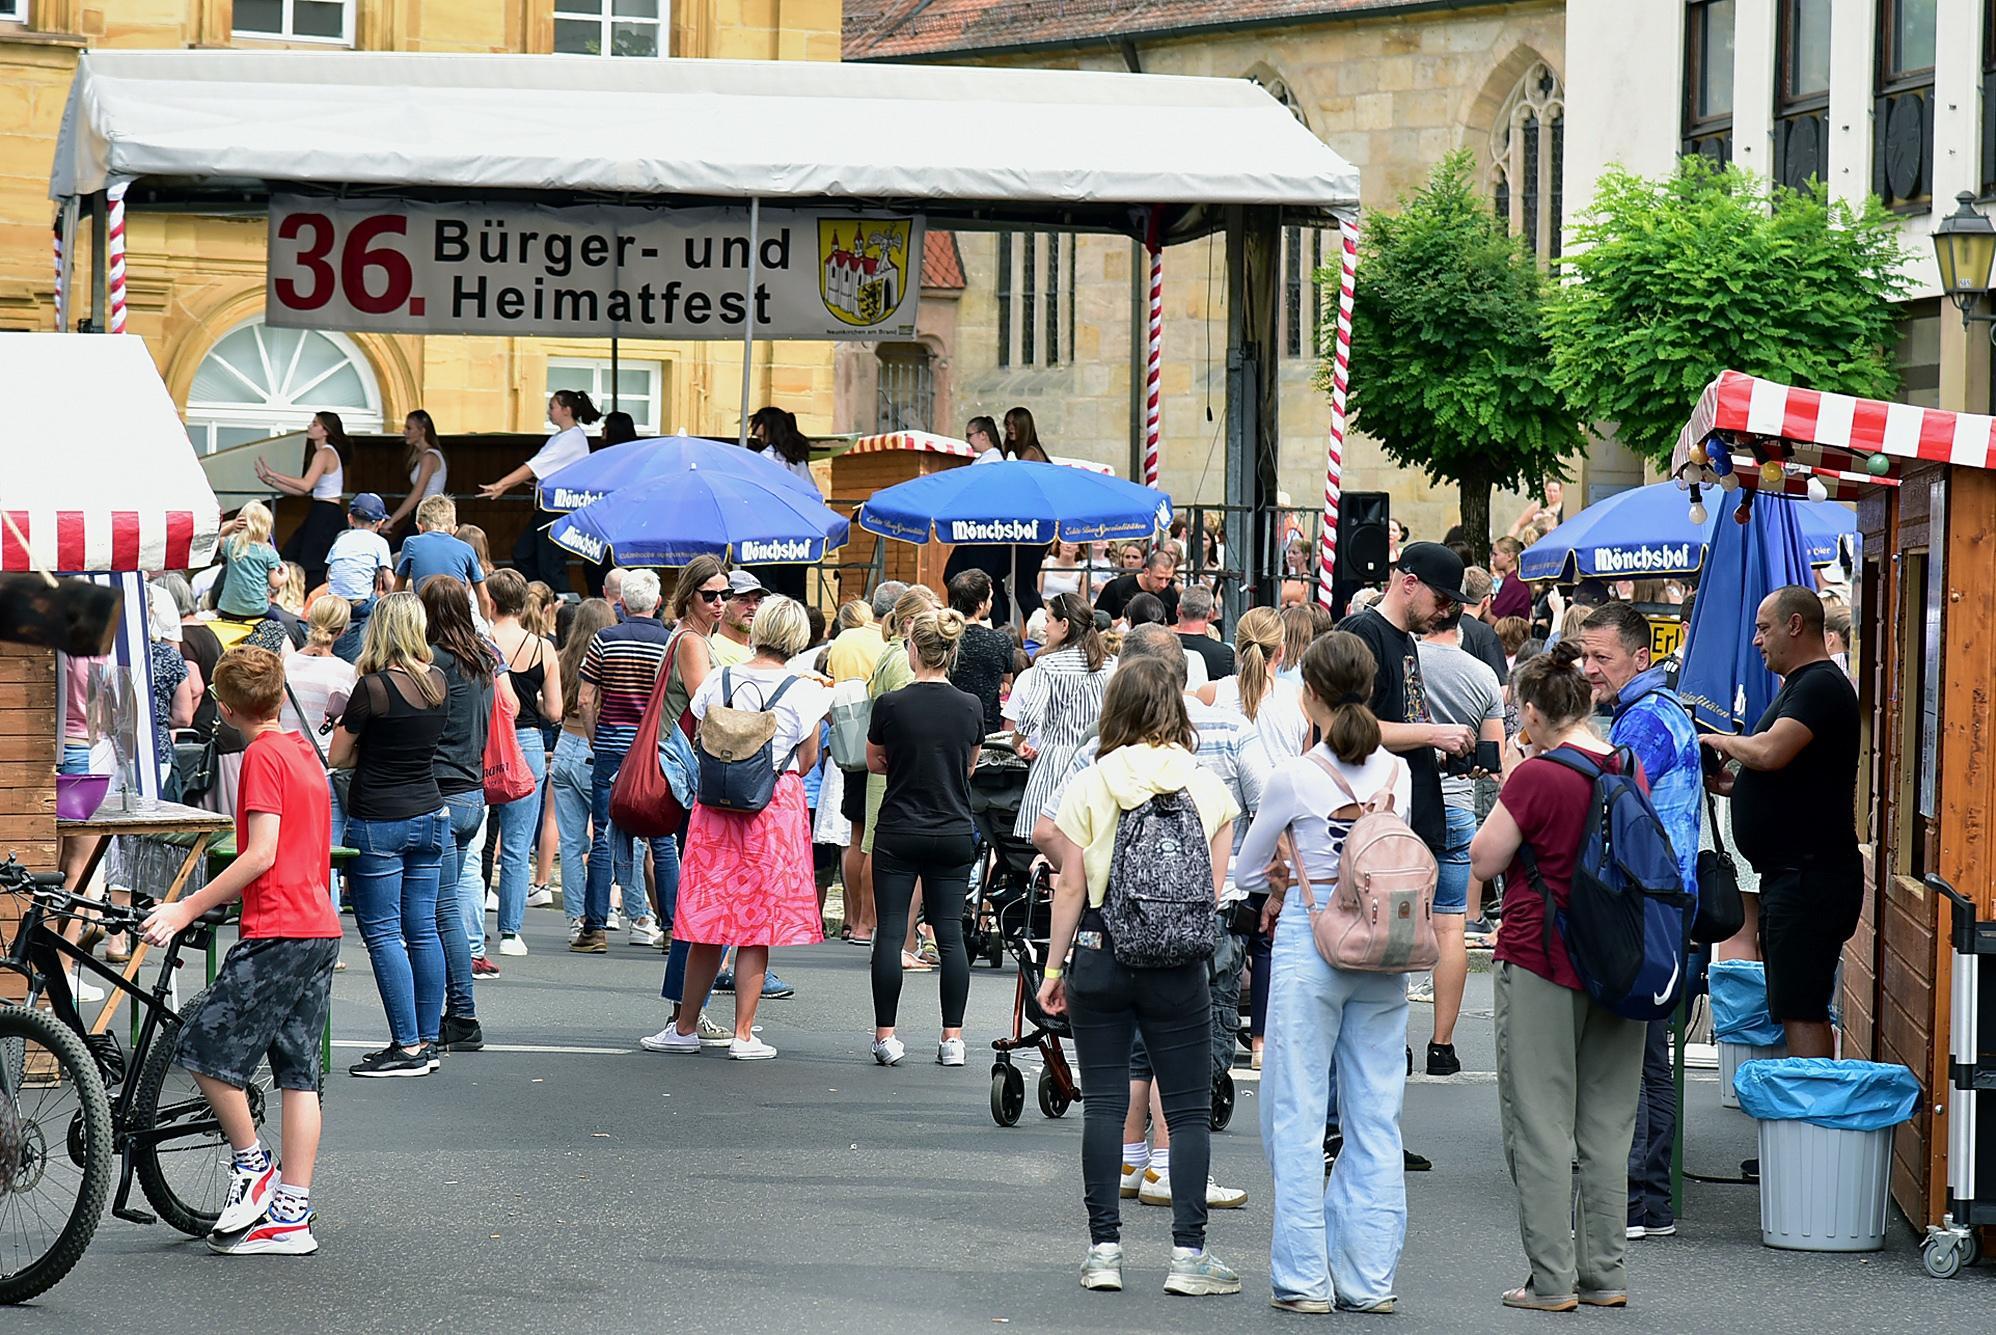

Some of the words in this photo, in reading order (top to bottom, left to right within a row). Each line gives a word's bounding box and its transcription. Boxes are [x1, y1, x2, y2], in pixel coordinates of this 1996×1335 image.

[434, 219, 658, 277] Bürger-
[685, 228, 790, 270] und
[274, 213, 425, 316] 36.
[452, 275, 772, 325] Heimatfest
[952, 519, 1039, 541] Mönchshof
[741, 538, 812, 562] Mönchshof
[1594, 543, 1690, 571] Mönchshof
[1652, 626, 1680, 654] Erl
